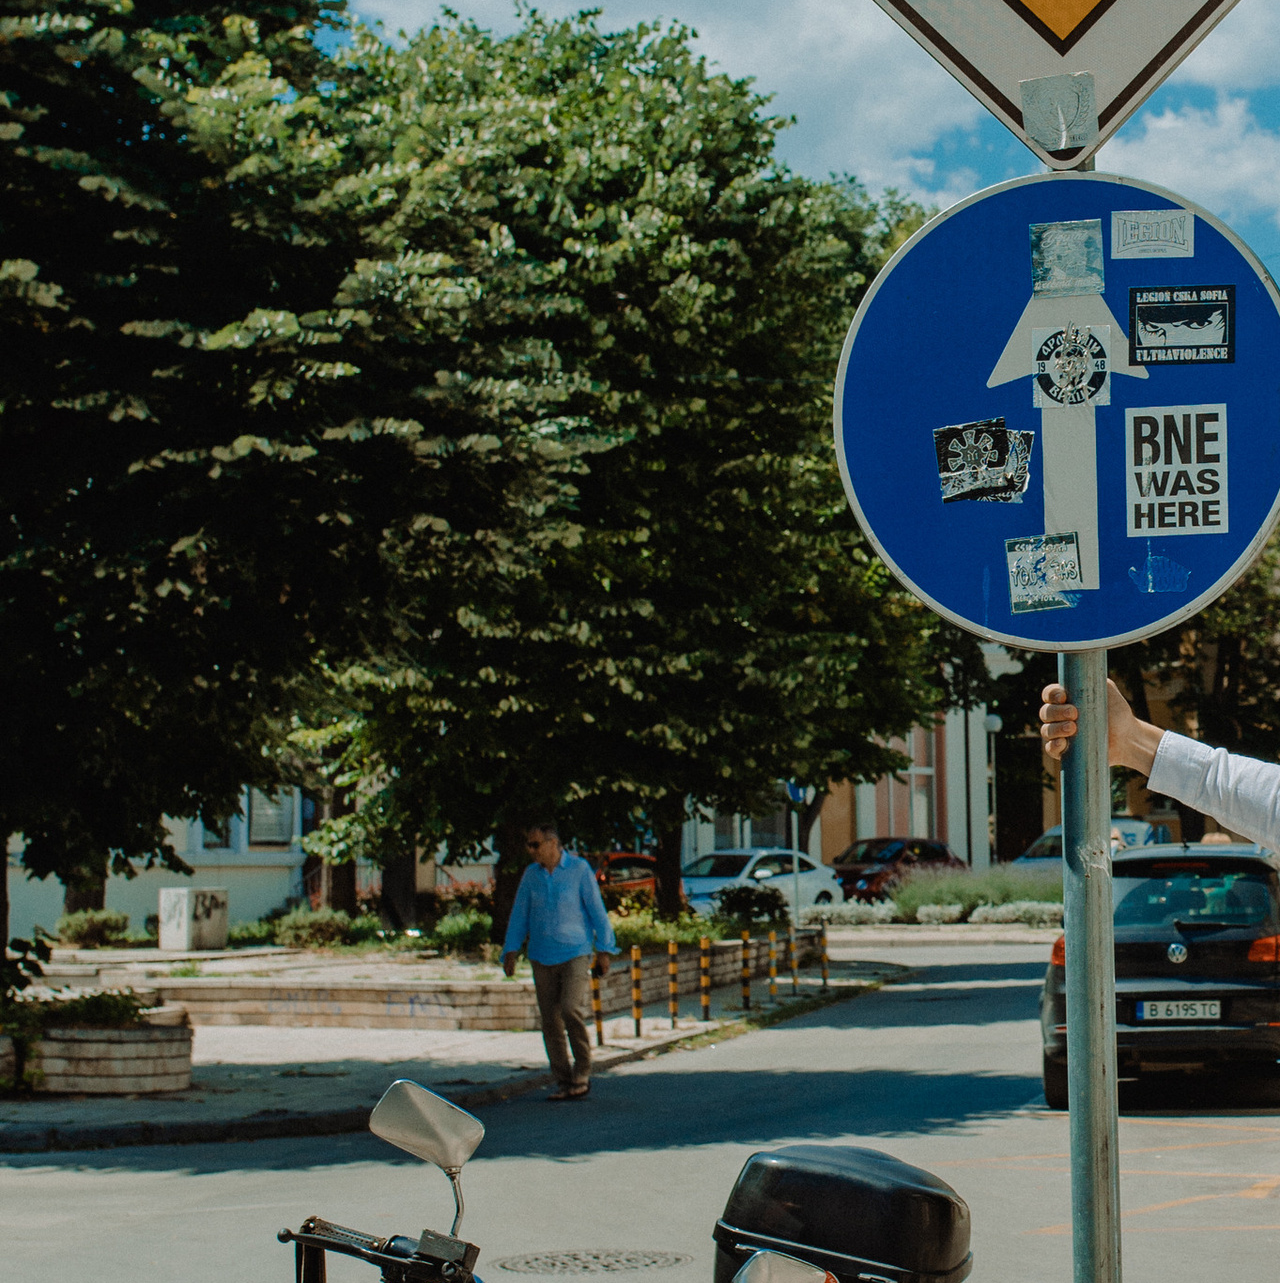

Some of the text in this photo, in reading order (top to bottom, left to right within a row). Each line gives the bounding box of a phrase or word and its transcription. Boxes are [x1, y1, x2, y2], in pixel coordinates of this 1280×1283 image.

[1117, 216, 1189, 253] LEGION
[1136, 289, 1228, 303] LEGION CSKA SOFIA
[1136, 347, 1229, 362] ULTRAVIOLENCE
[1037, 361, 1046, 373] 19
[1094, 359, 1106, 371] 48
[1133, 412, 1221, 467] BNE
[1134, 468, 1221, 498] WAS
[1134, 500, 1221, 530] HERE
[1149, 1003, 1218, 1017] B 6195 TC
